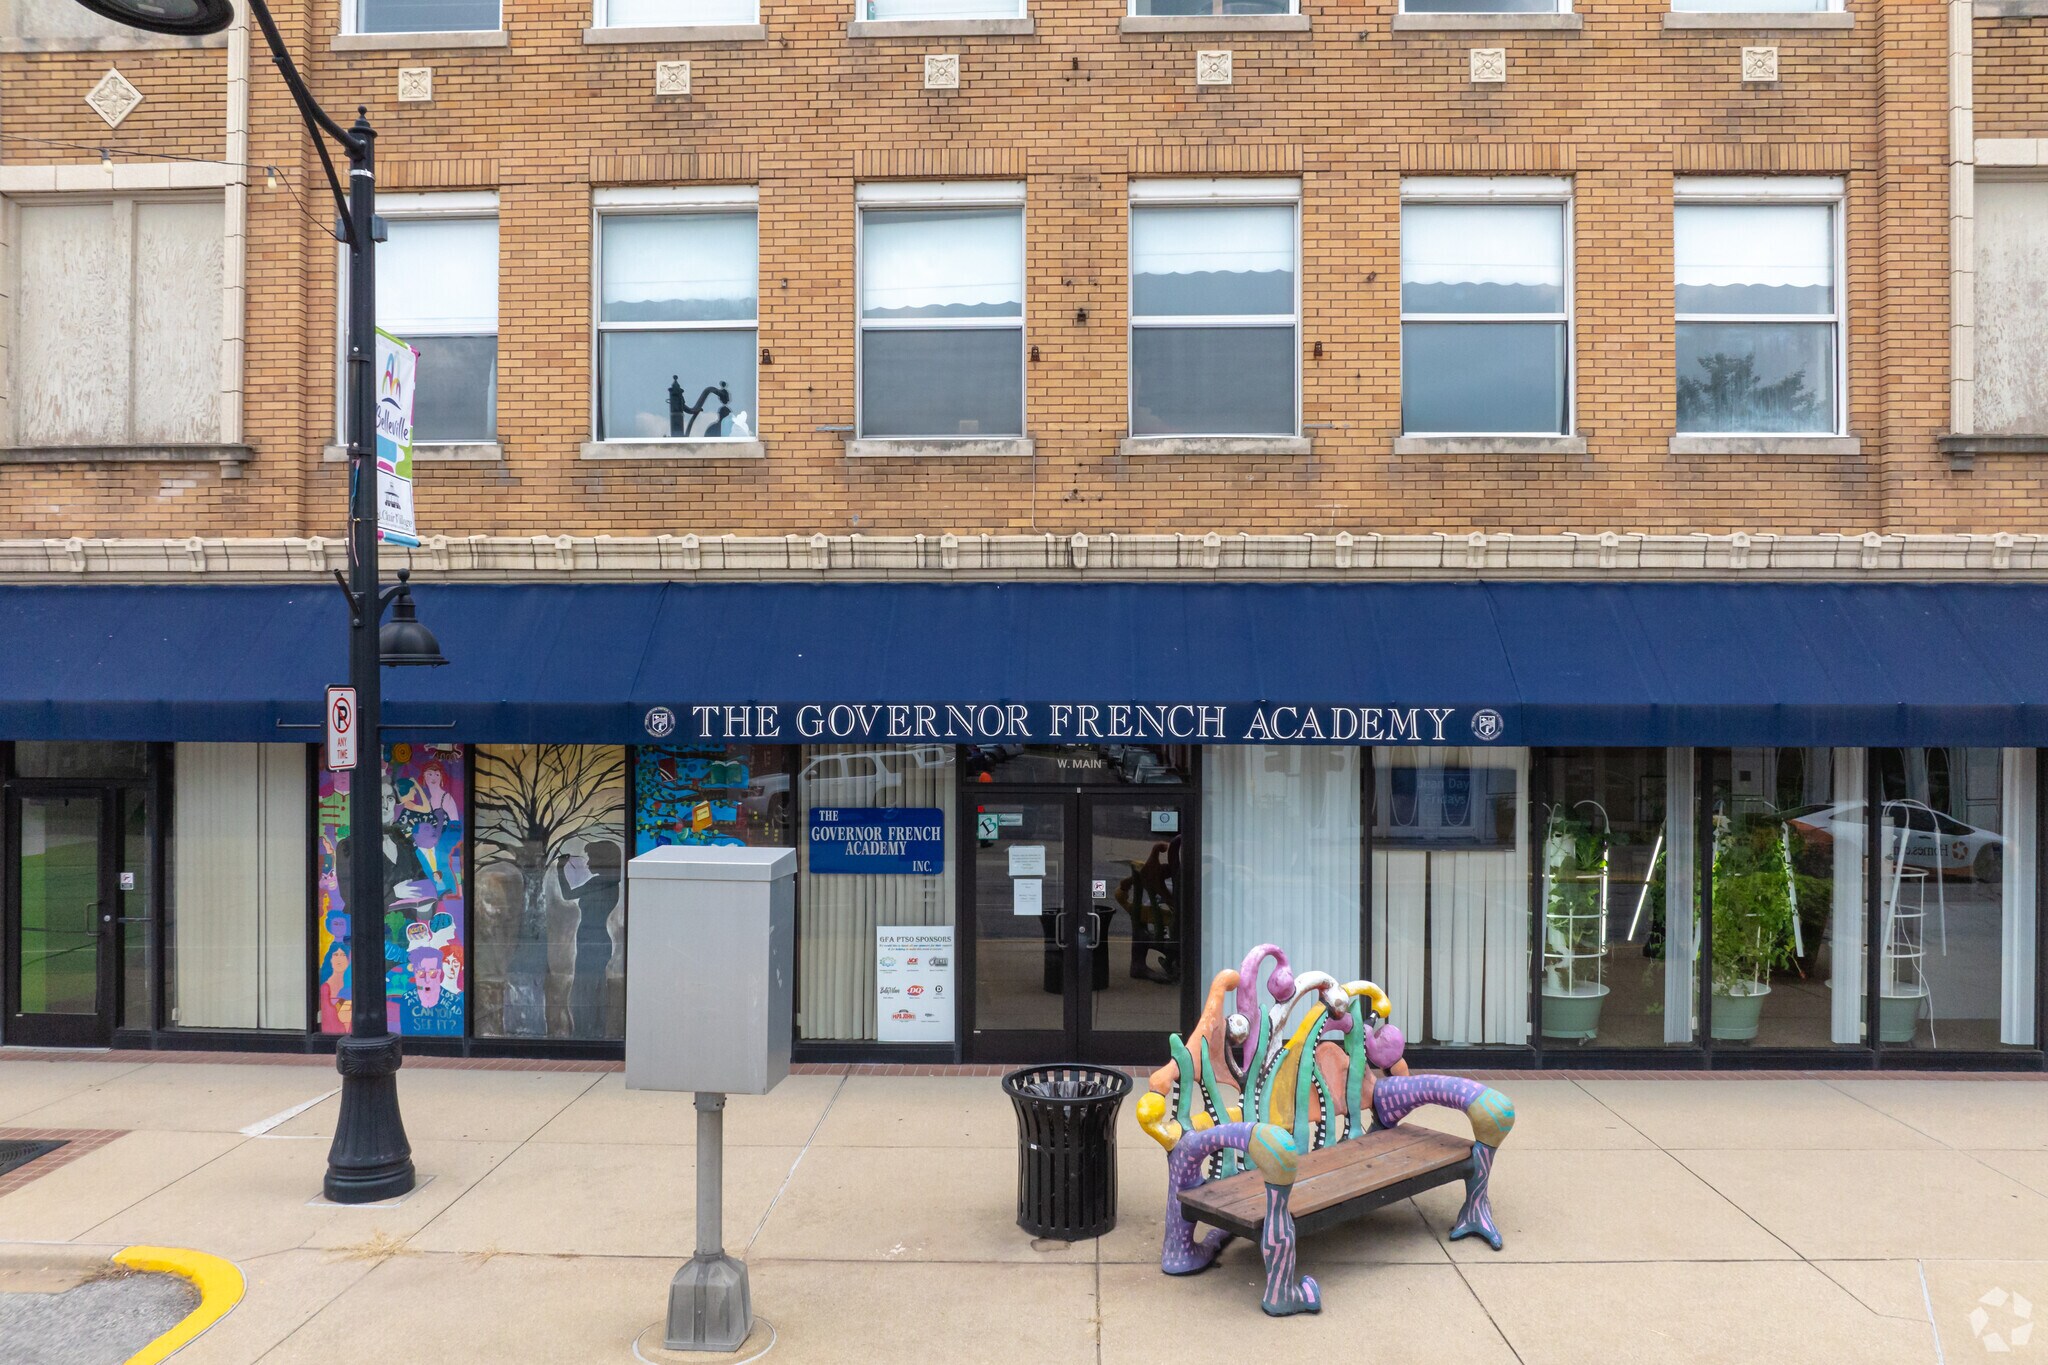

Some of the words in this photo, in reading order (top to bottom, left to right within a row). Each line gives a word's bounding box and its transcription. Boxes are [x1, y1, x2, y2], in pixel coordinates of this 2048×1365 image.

[692, 705, 781, 738] THE
[795, 704, 1033, 738] GOVERNOR
[1049, 704, 1227, 739] FRENCH
[1242, 705, 1456, 742] ACADEMY
[337, 737, 348, 747] ANY
[337, 749, 348, 759] TIME
[1057, 759, 1070, 769] W.
[1072, 759, 1102, 769] MAIN
[1448, 778, 1471, 792] Day
[818, 810, 839, 822] THE
[811, 826, 882, 842] GOVERNOR
[888, 826, 941, 841] FRENCH
[845, 841, 907, 856] ACADEMY
[912, 860, 932, 872] INC.
[411, 1005, 434, 1017] CAN
[436, 1019, 457, 1031] IT?
